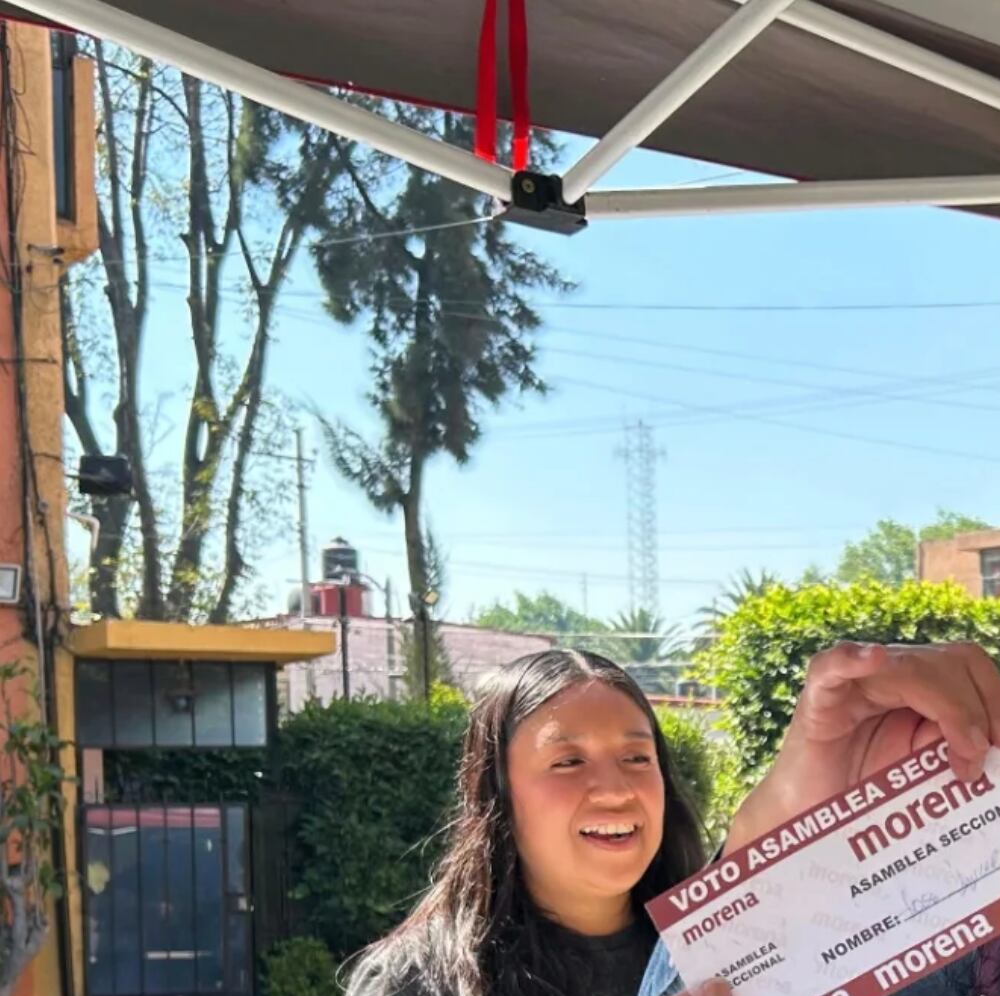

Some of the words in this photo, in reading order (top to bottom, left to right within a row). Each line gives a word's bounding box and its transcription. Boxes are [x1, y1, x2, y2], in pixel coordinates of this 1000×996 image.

[847, 771, 995, 863] morena
[668, 861, 741, 912] VOTO
[747, 782, 887, 871] ASAMBLEA
[849, 842, 938, 899] ASAMBLEA
[682, 891, 760, 946] morena
[821, 914, 902, 965] NOMBRE:
[728, 953, 786, 991] ECCIONAL
[873, 912, 994, 990] morena
